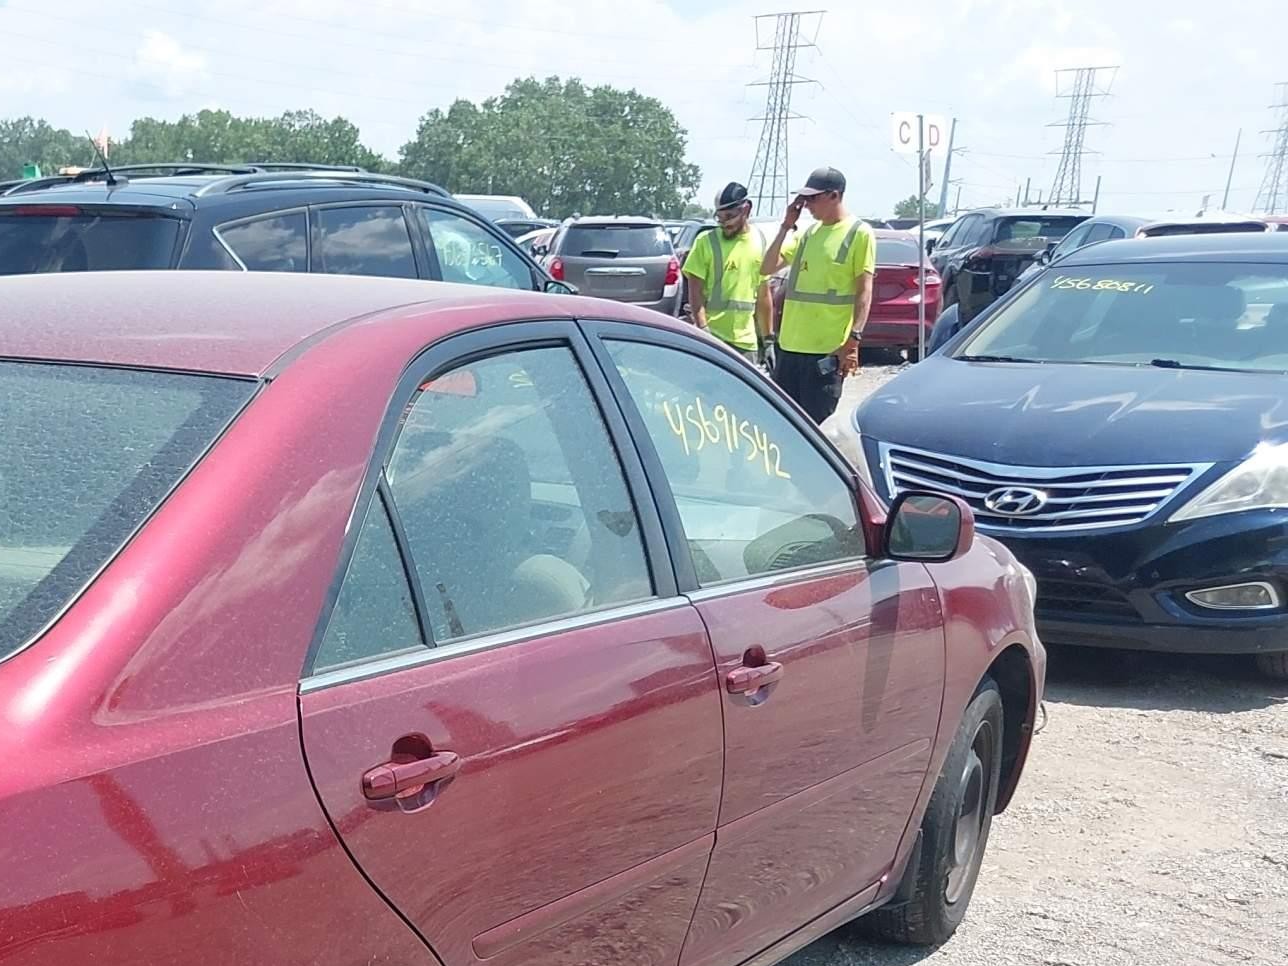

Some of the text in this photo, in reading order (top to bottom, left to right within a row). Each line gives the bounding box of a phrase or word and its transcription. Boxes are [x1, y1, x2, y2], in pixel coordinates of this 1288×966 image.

[899, 121, 911, 145] C
[928, 124, 940, 147] D
[662, 396, 792, 481] 45691542
